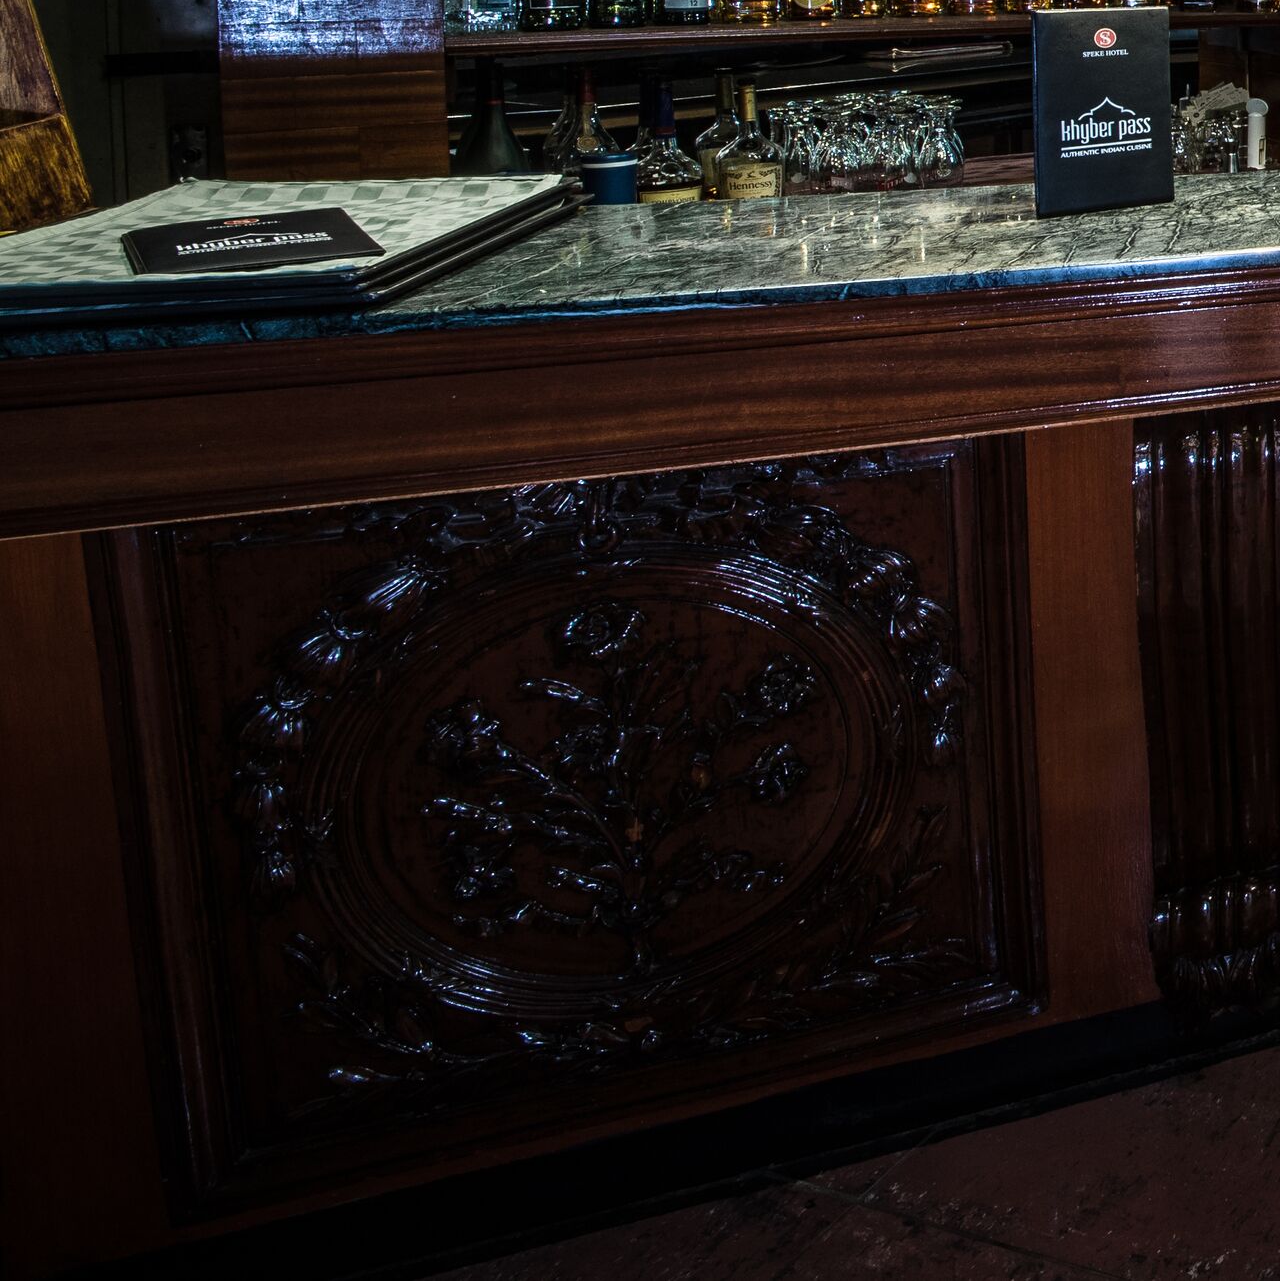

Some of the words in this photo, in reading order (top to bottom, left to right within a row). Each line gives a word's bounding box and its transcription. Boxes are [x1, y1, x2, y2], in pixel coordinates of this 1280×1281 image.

[689, 0, 698, 7] 12
[1061, 117, 1115, 144] khyber
[1118, 117, 1151, 140] pass
[1060, 148, 1100, 158] AUTHENTIC
[1100, 145, 1125, 154] INDIAN
[1126, 142, 1153, 151] CUISINE
[729, 180, 773, 191] Hennessy
[176, 237, 265, 252] khyber
[272, 231, 330, 242] pass
